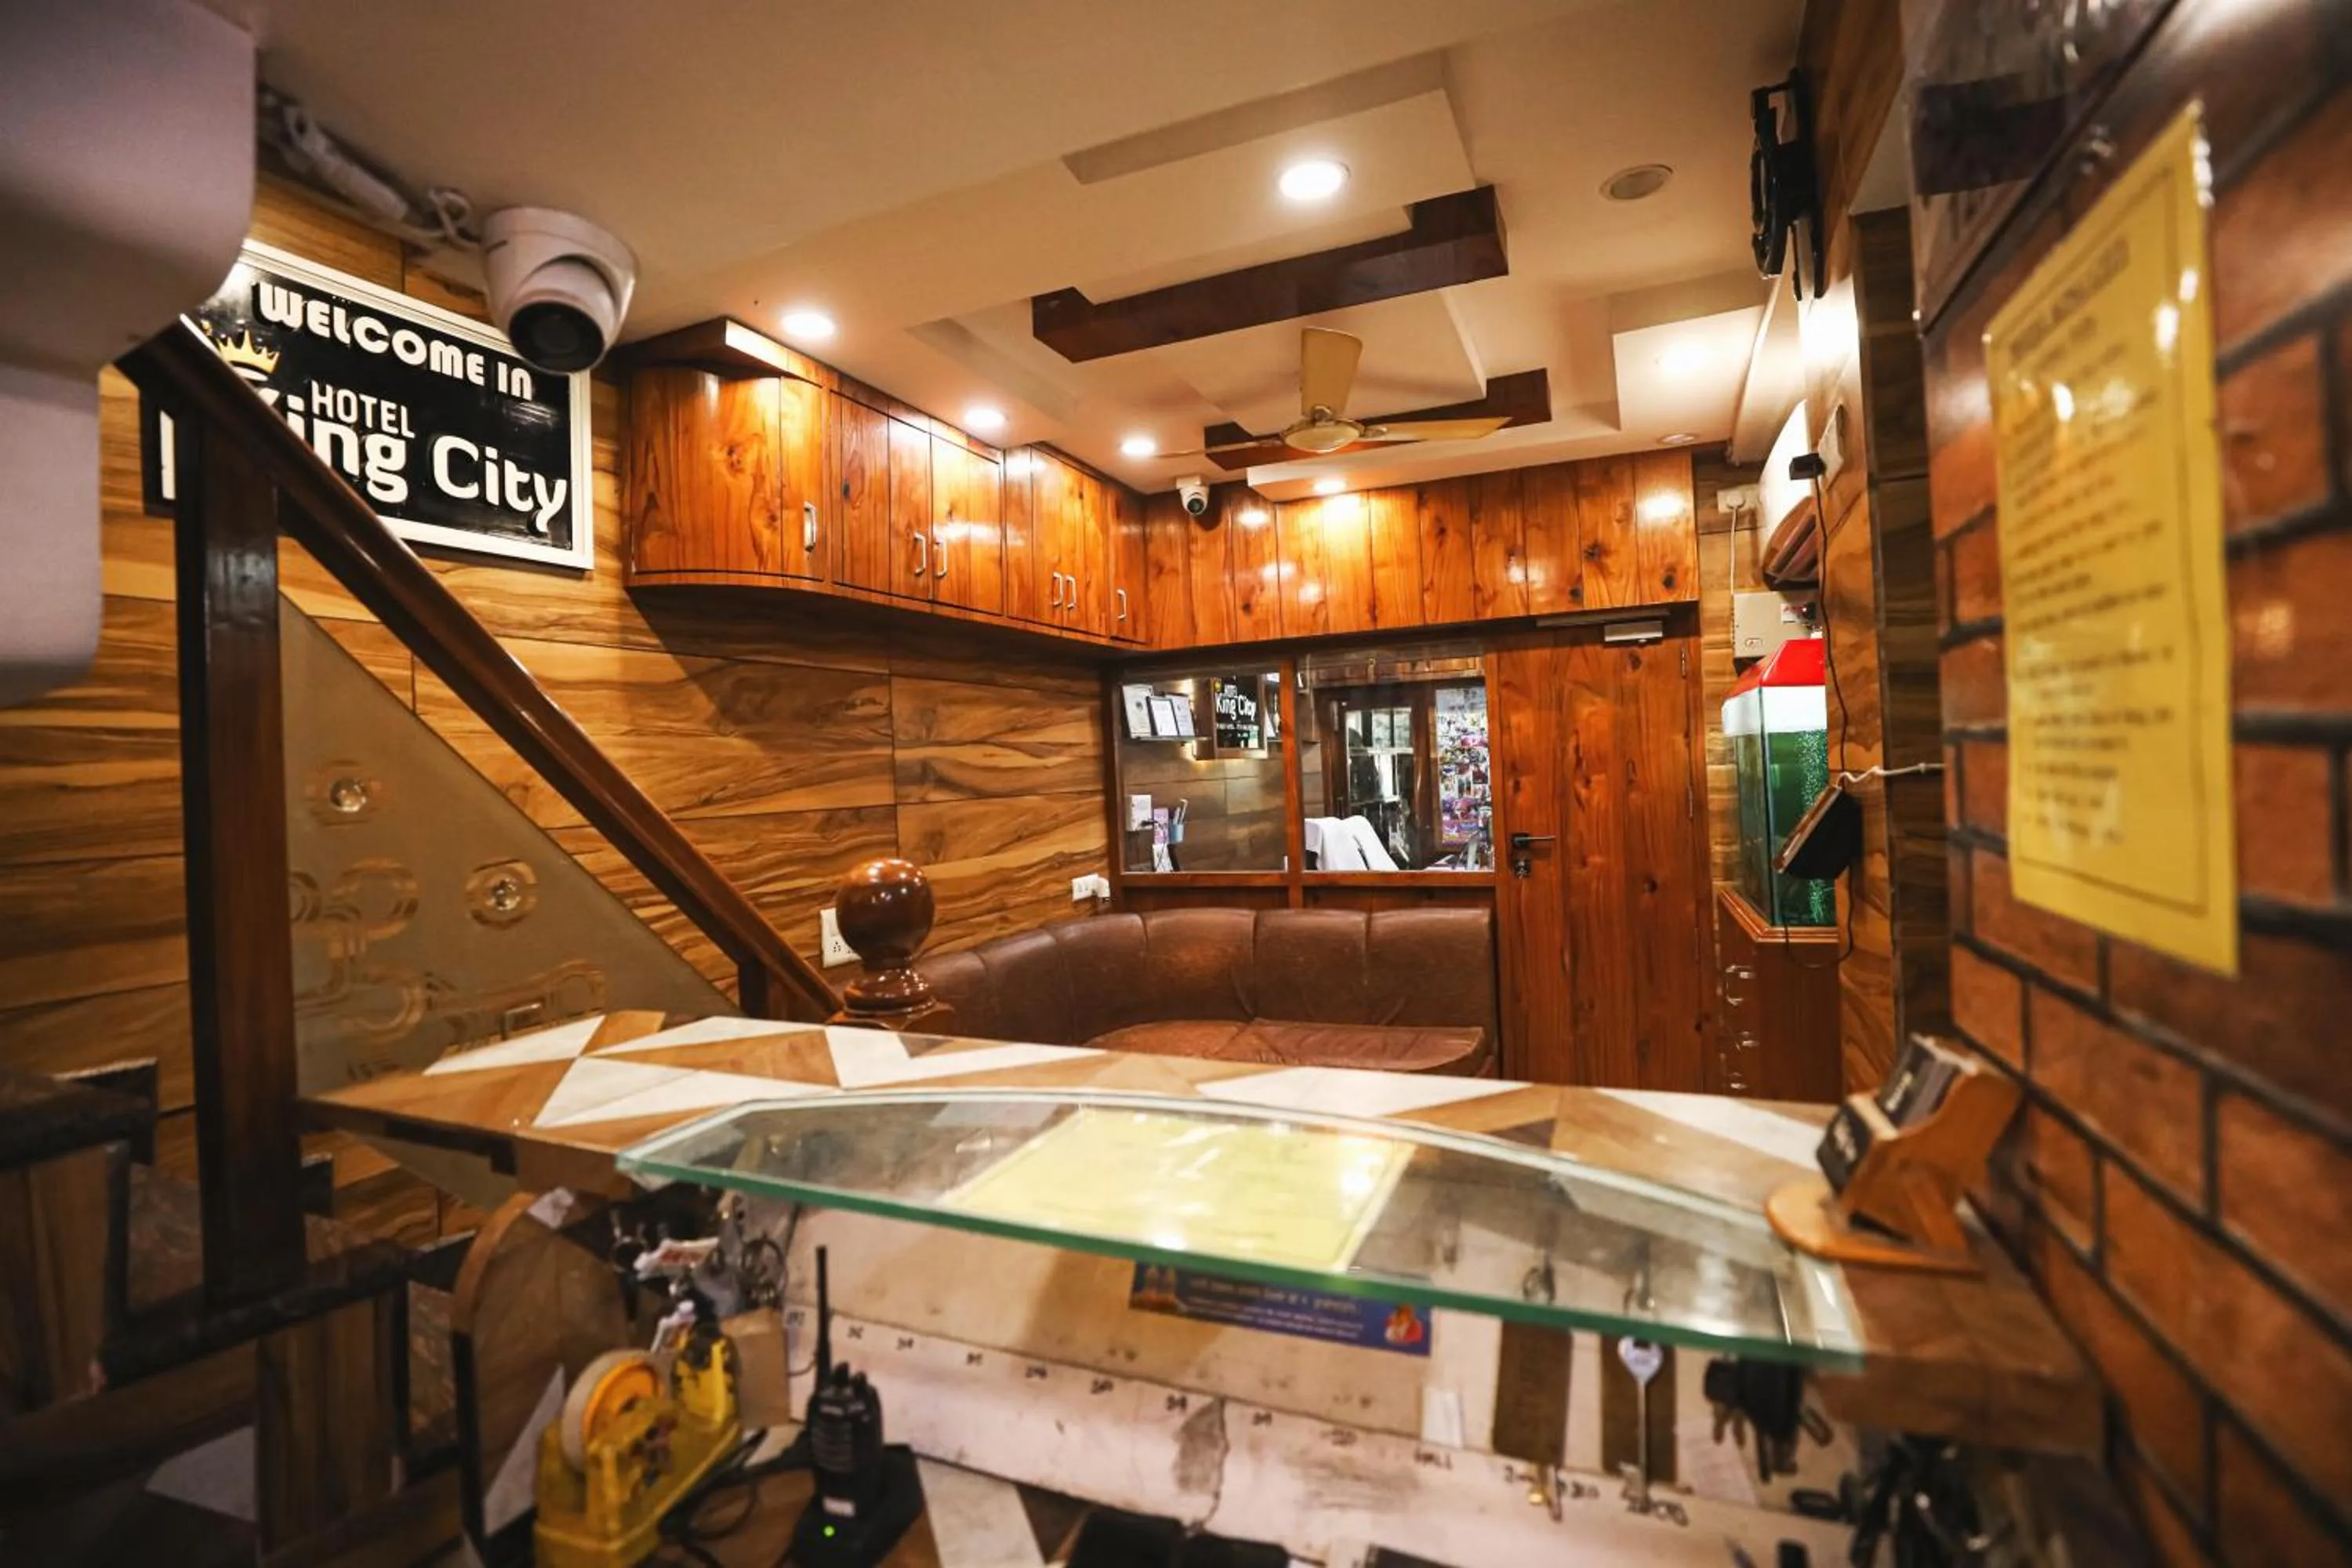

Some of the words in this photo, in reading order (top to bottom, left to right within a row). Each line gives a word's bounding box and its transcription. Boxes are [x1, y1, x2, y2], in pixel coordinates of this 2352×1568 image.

[259, 282, 486, 386] WELCOME
[311, 379, 416, 438] HOTEL
[432, 434, 567, 533] City
[1215, 692, 1236, 720] King
